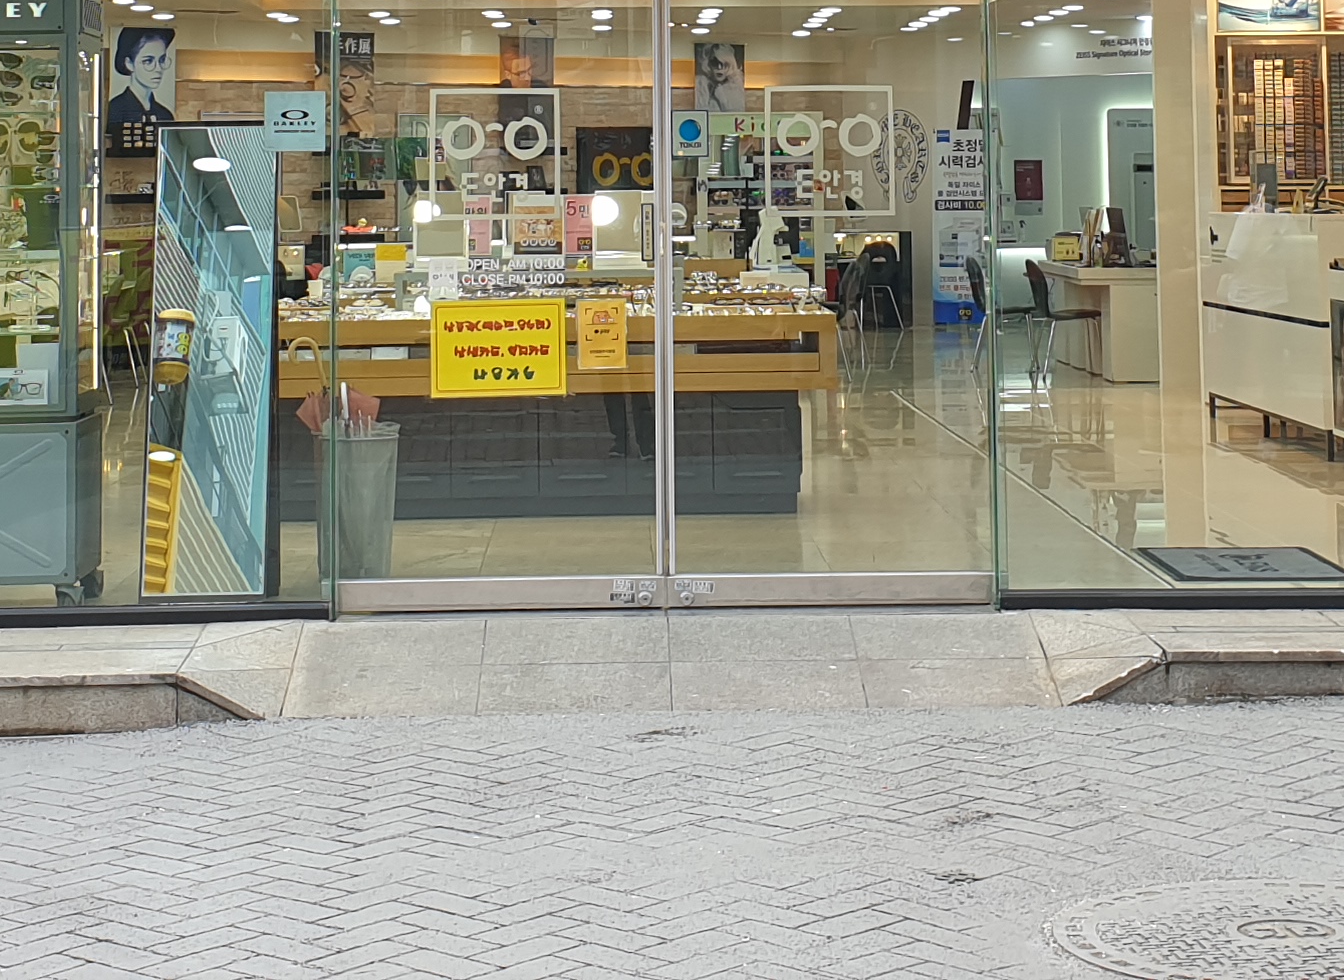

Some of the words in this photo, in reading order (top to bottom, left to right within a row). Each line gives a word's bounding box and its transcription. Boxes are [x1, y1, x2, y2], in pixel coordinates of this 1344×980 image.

[937, 201, 962, 210] 검사비
[466, 257, 501, 270] OPEN
[461, 273, 504, 285] CLOSE
